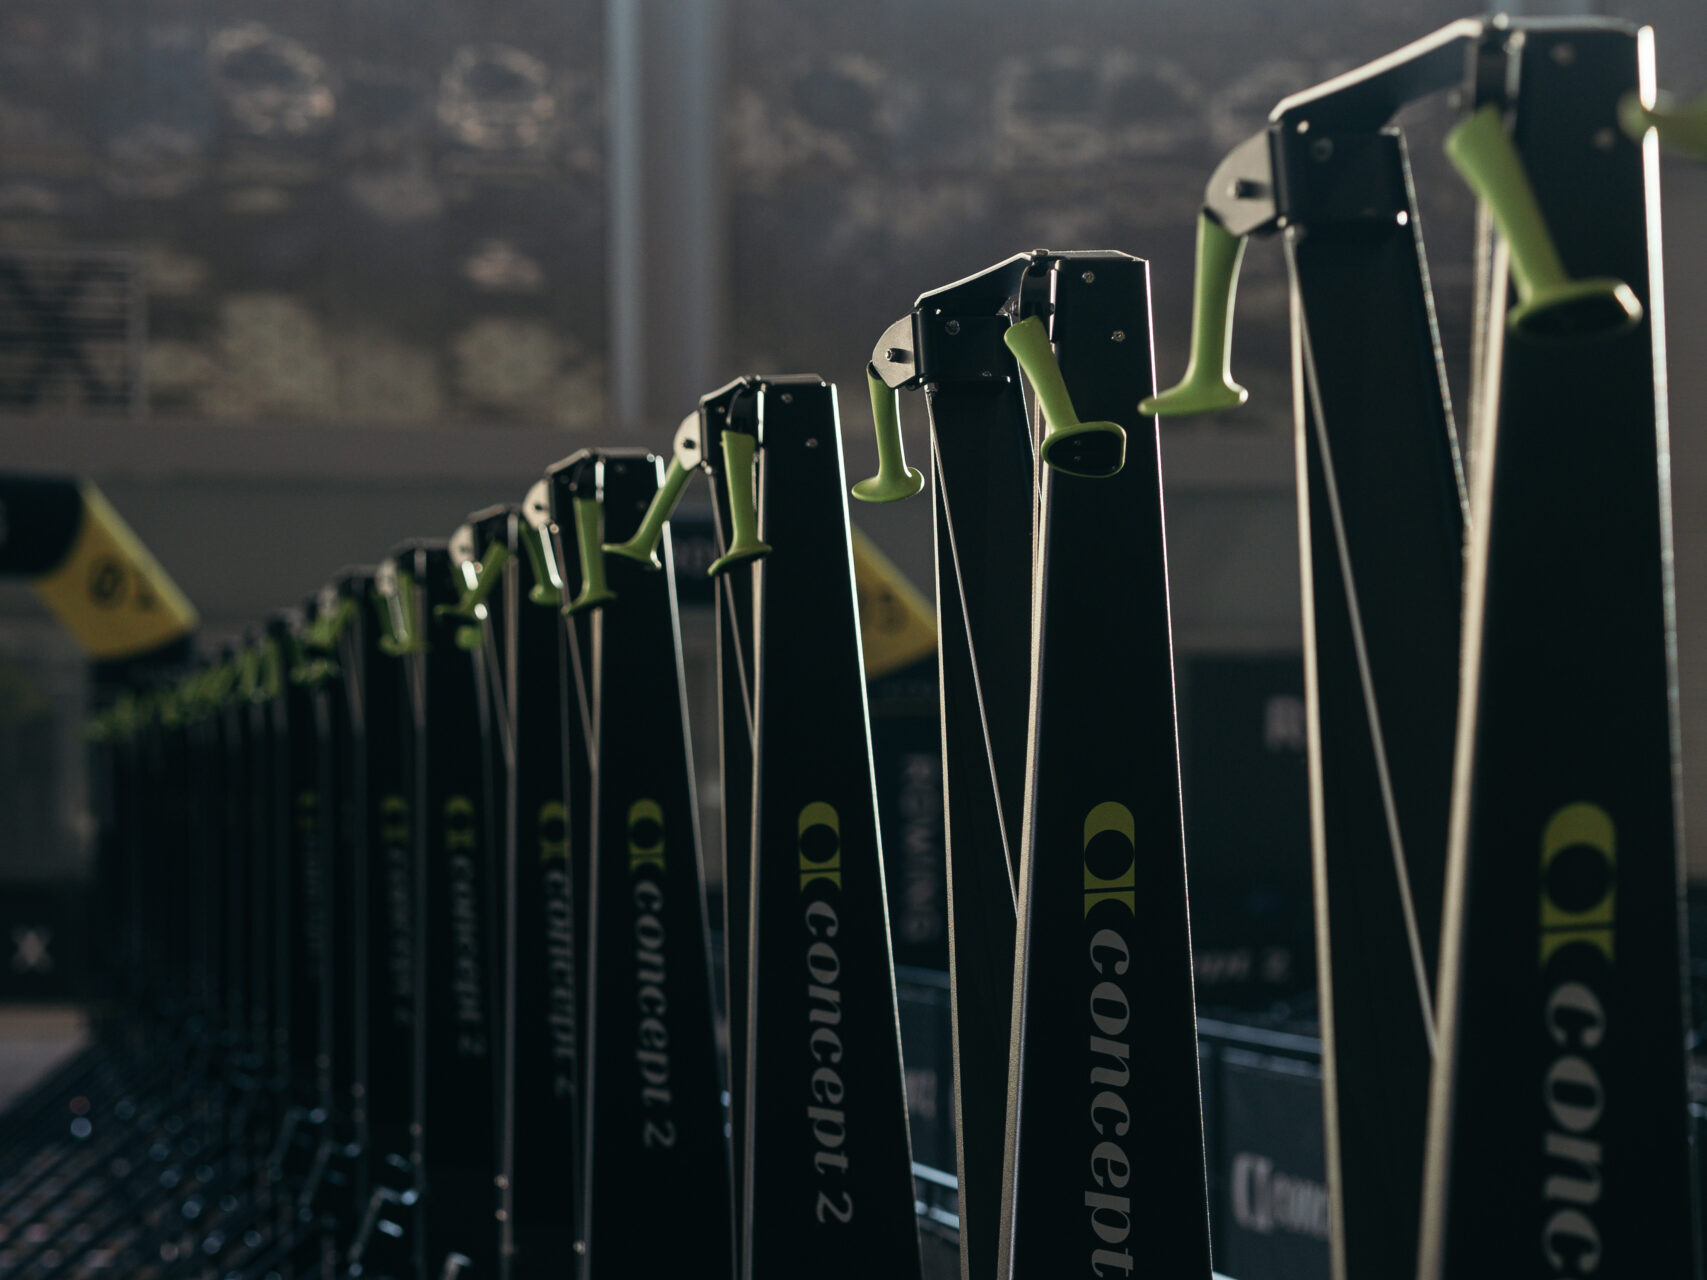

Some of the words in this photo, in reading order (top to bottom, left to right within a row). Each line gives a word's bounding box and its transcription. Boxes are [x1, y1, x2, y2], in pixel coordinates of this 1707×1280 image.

[634, 877, 674, 1106] concept
[805, 899, 850, 1176] concept
[1084, 928, 1134, 1279] concept
[642, 1120, 677, 1150] 2
[815, 1190, 854, 1225] 2
